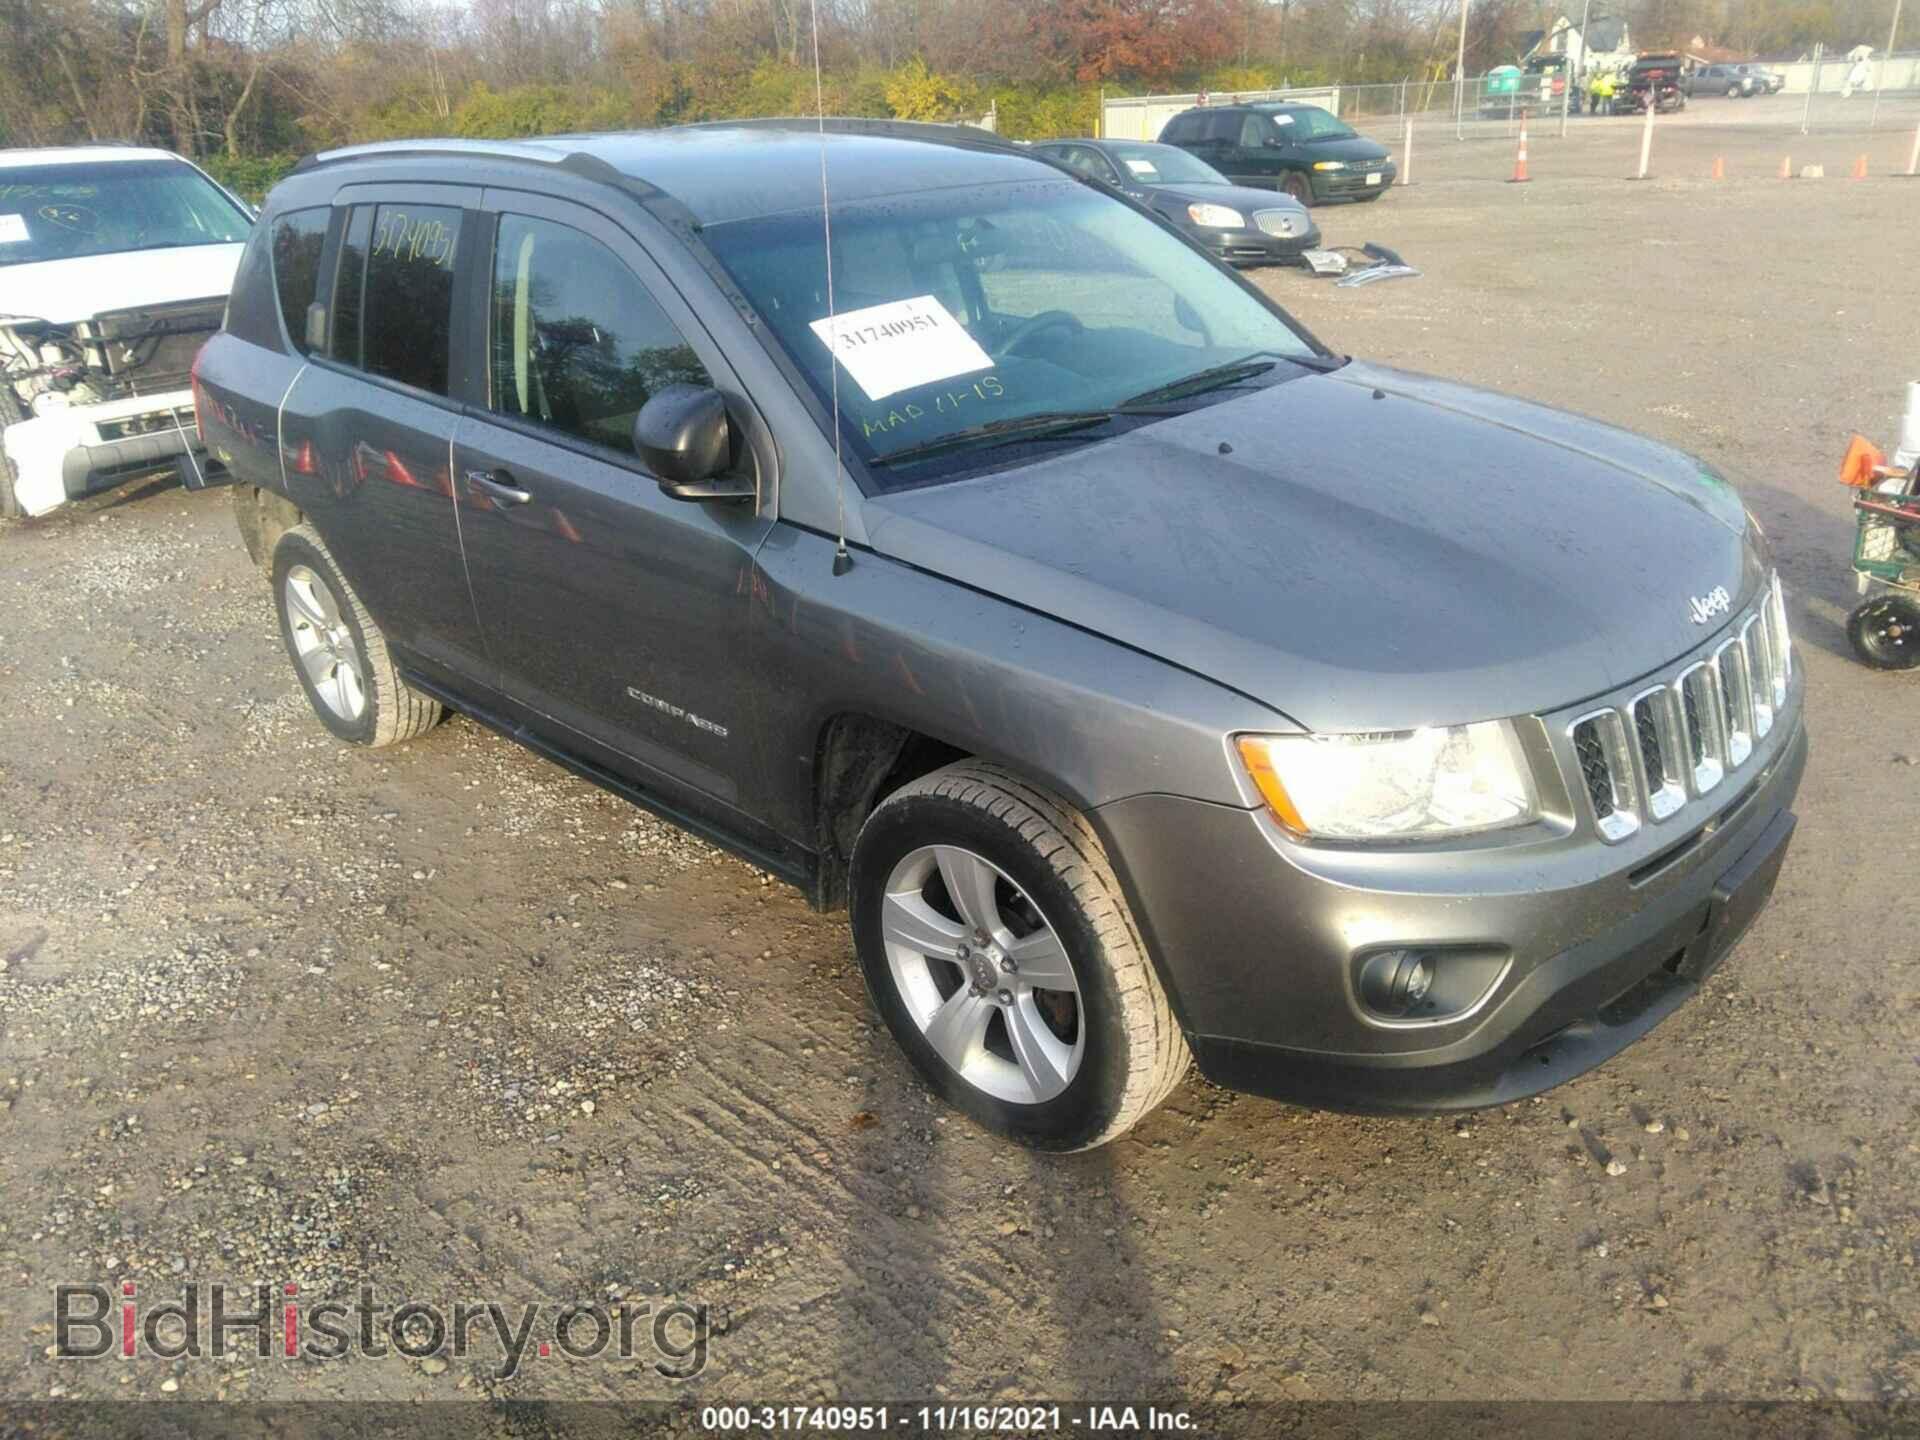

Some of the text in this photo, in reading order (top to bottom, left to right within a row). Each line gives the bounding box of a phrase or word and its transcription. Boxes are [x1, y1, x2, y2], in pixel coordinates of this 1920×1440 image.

[372, 209, 458, 272] 31740951
[840, 314, 938, 349] 31740951
[1689, 585, 1730, 624] Jeep
[626, 686, 728, 737] COMPASS
